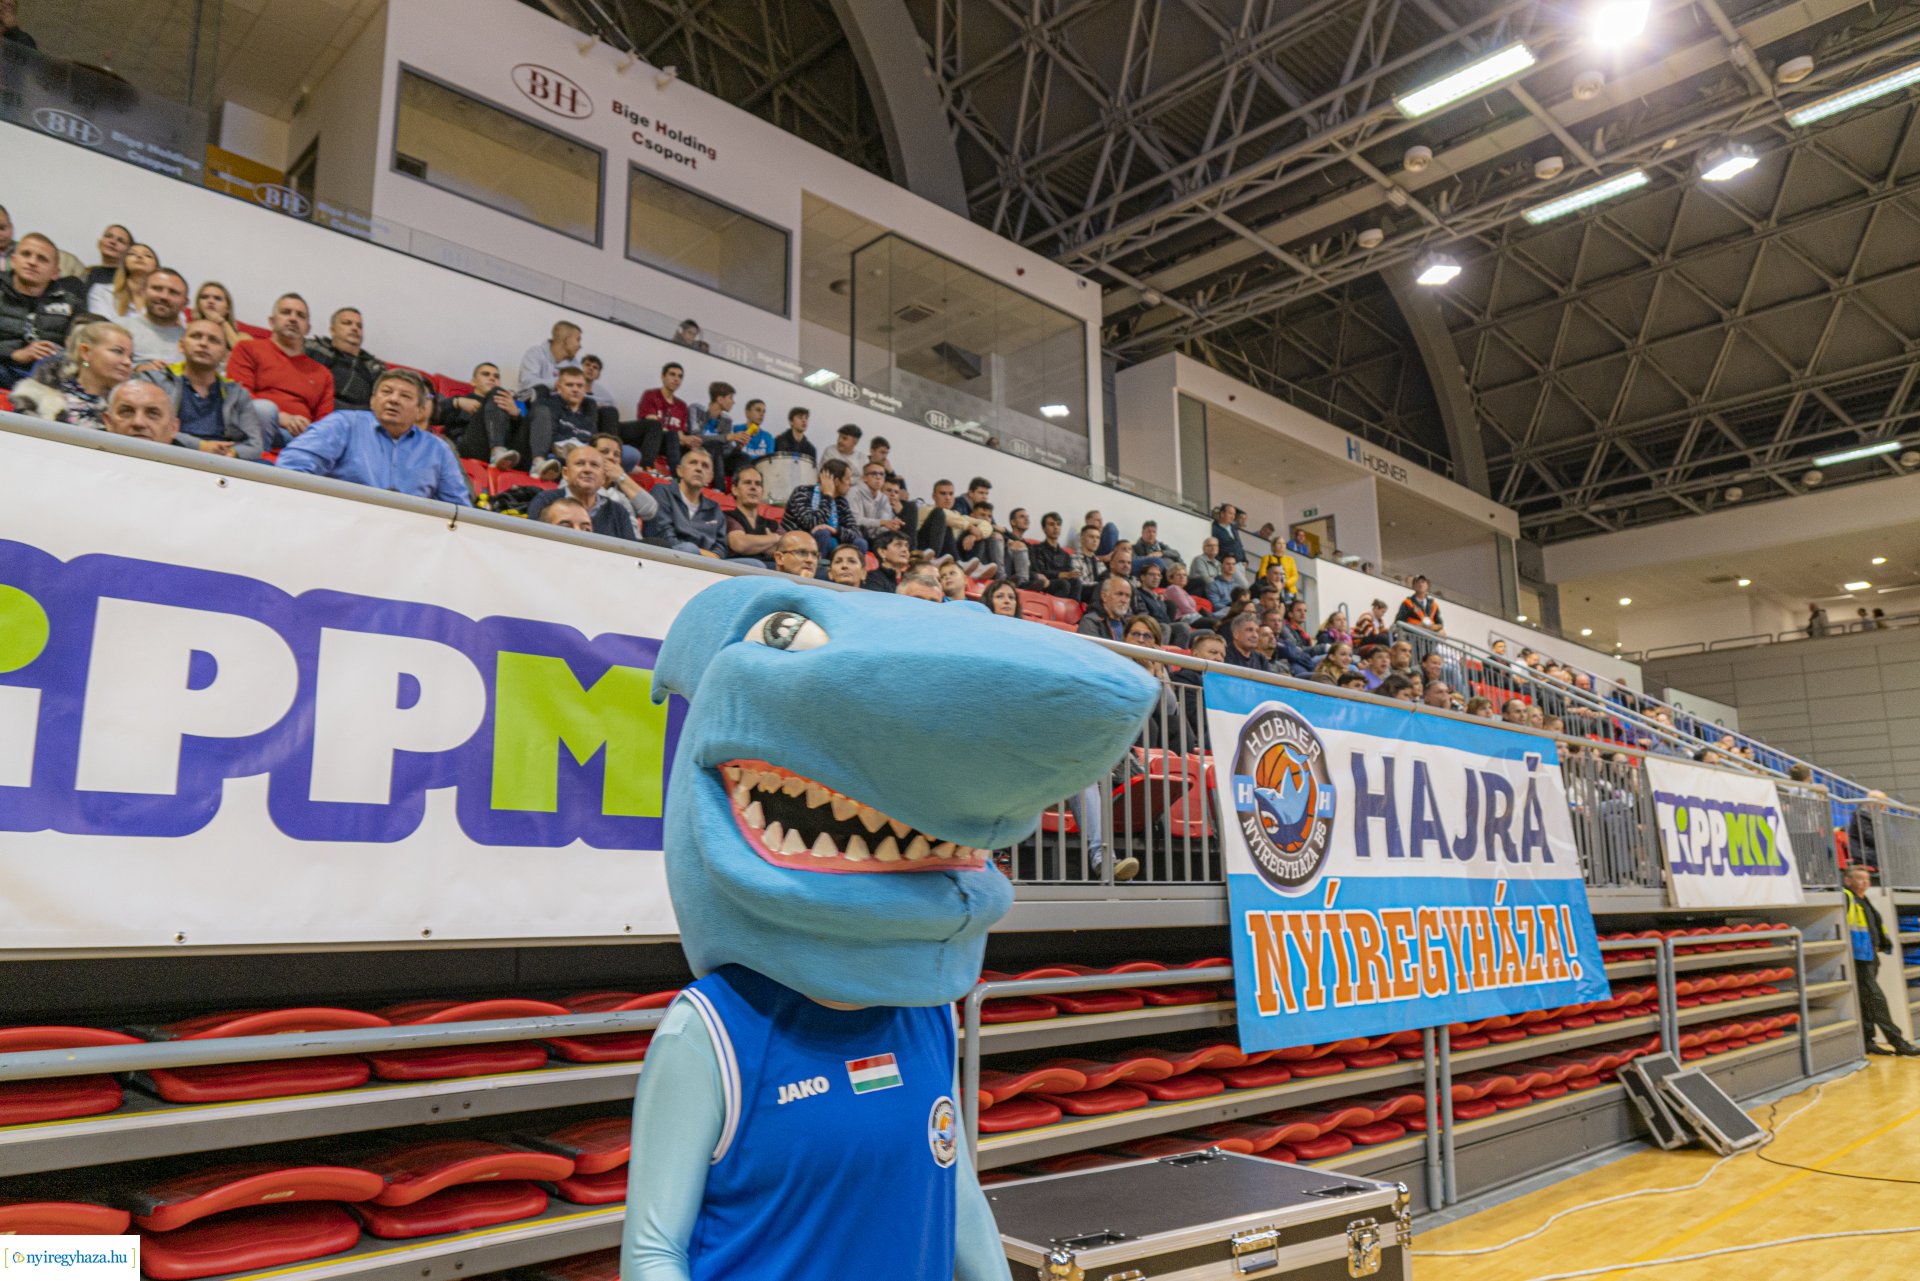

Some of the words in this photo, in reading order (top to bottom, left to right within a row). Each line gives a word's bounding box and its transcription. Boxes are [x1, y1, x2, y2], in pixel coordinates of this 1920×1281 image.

[529, 69, 579, 115] BH
[47, 111, 91, 143] BH
[611, 100, 650, 127] Bige
[655, 120, 718, 161] Holding
[631, 131, 698, 170] Csoport
[264, 186, 301, 213] BH
[834, 380, 855, 398] BH
[929, 413, 949, 429] BH
[1245, 716, 1321, 763] HÜBNER
[1351, 751, 1555, 864] HAJRÁ
[1242, 816, 1320, 880] NYÍREGYHÁZA
[1313, 820, 1327, 850] BS
[1247, 879, 1583, 1015] NYÍREGYHÁZA!
[777, 1076, 831, 1105] JAKO
